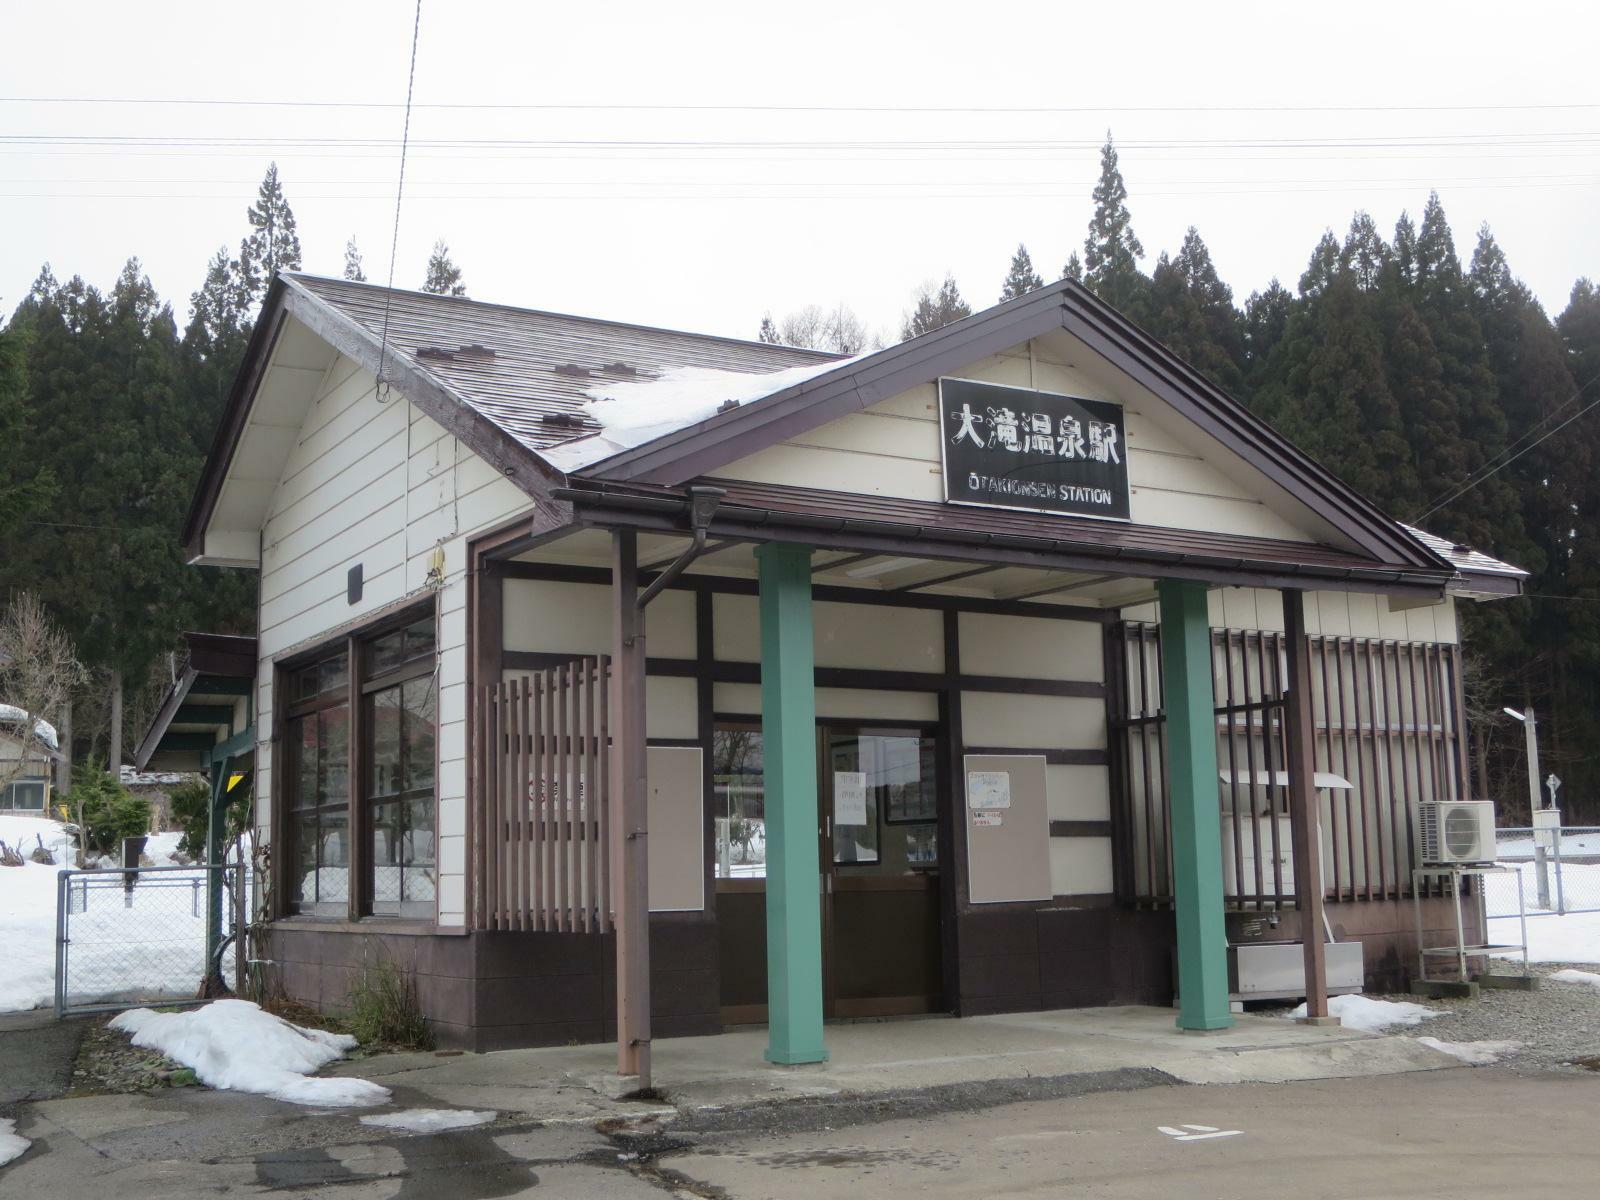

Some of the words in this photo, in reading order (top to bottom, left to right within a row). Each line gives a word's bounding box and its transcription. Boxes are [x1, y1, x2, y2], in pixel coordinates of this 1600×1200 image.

[951, 403, 1120, 464] 大滝温泉駅
[1060, 484, 1112, 505] STATION
